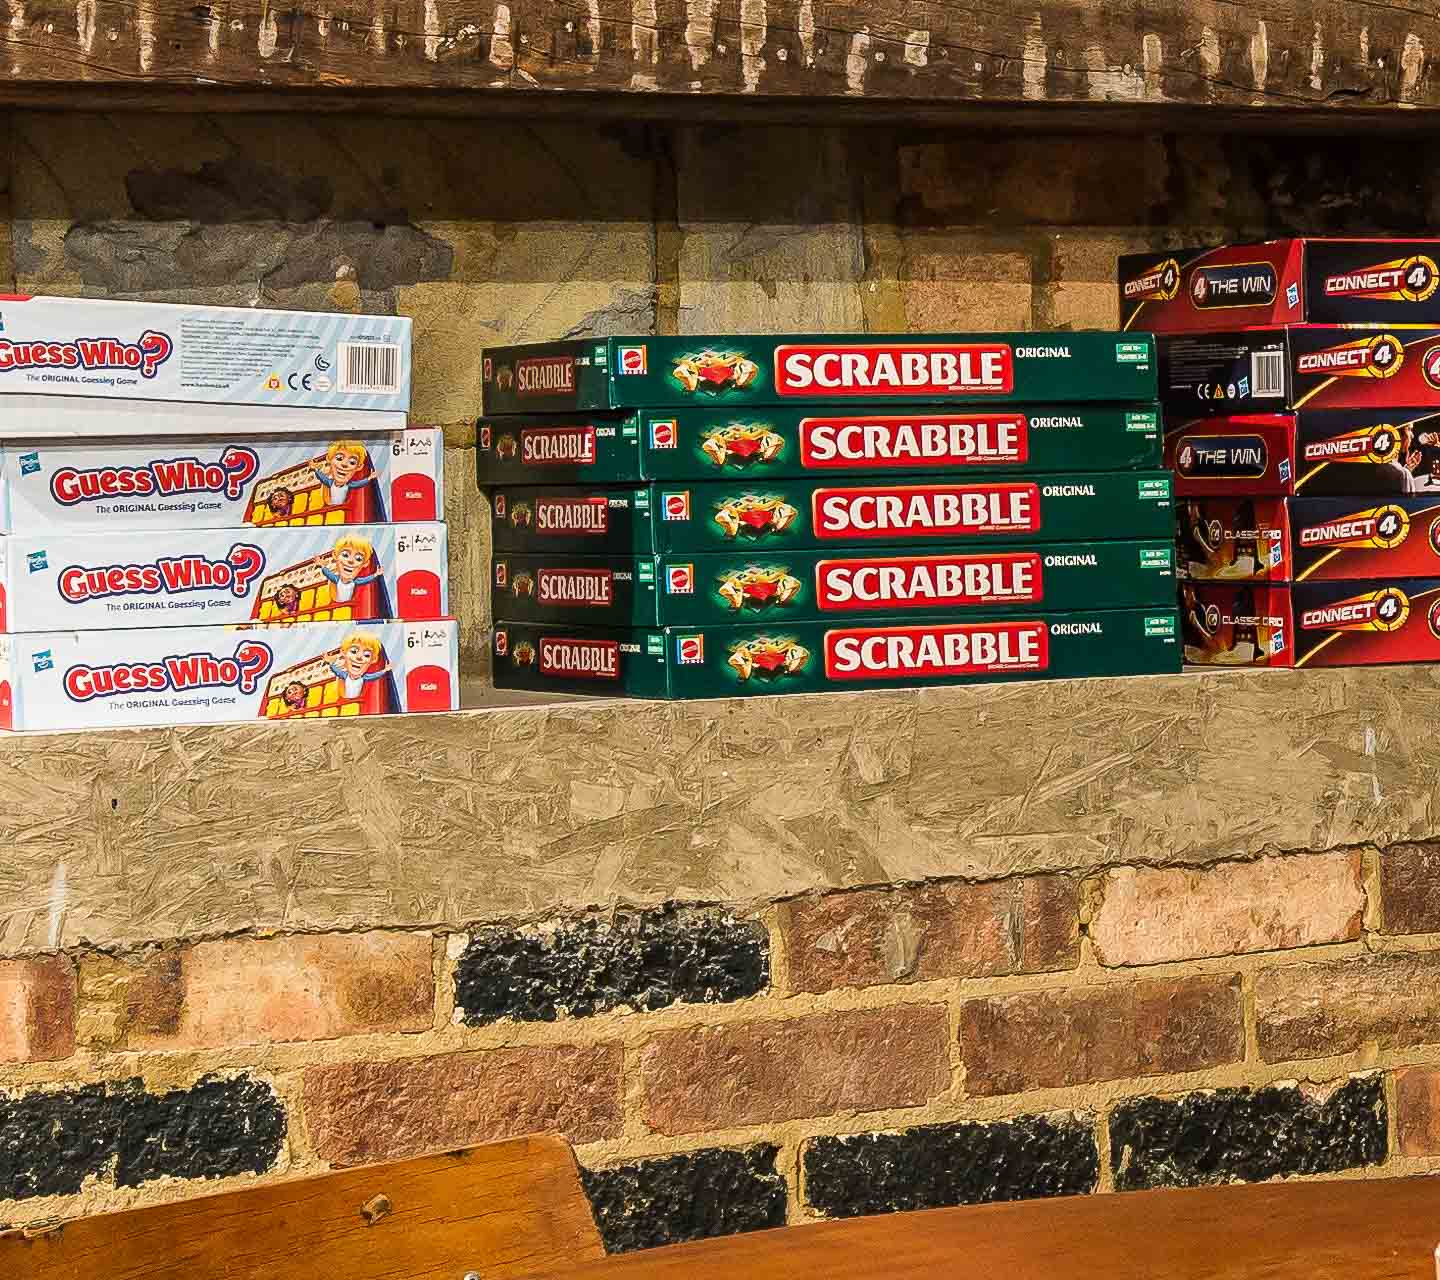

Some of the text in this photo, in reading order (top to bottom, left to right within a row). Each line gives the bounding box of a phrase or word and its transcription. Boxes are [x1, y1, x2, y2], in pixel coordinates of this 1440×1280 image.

[1124, 269, 1174, 295] CONNECT 4
[1193, 275, 1271, 299] 4 THE WIN
[1325, 266, 1427, 293] CONNECT 4
[77, 329, 174, 379] Who?
[785, 346, 1072, 388] SCRABBLE ORIGINAL
[1298, 344, 1392, 370] CONNECT 4
[26, 373, 40, 382] The
[41, 374, 80, 383] ORIGINAL
[518, 363, 573, 391] SCRABBLE
[523, 432, 593, 459] SCRABBLE
[810, 416, 1084, 461] SCRABBLE ORIGINAL
[1305, 434, 1390, 458] CONNECT 4
[1179, 446, 1261, 468] 4 THE WIN
[50, 445, 260, 505] Guess Who?
[95, 504, 111, 514] The
[112, 502, 157, 513] ORIGINAL
[538, 504, 606, 529] SCRABBLE
[822, 484, 1096, 531] SCRABBLE ORIGINAL
[1301, 515, 1397, 543] CONNECT 4
[58, 542, 266, 603] Guess Who?
[826, 554, 1098, 602] SCRABBLE ORIGINAL
[540, 575, 609, 601] SCRABBLE
[106, 602, 122, 612] The
[122, 600, 167, 611] ORIGINAL
[1303, 598, 1397, 626] CONNECT 4
[543, 644, 616, 672] SCRABBLE
[834, 623, 1103, 672] SCRABBLE ORIGINAL
[63, 640, 274, 701] Guess Who?
[109, 700, 125, 710] The
[125, 698, 170, 709] ORIGINAL
